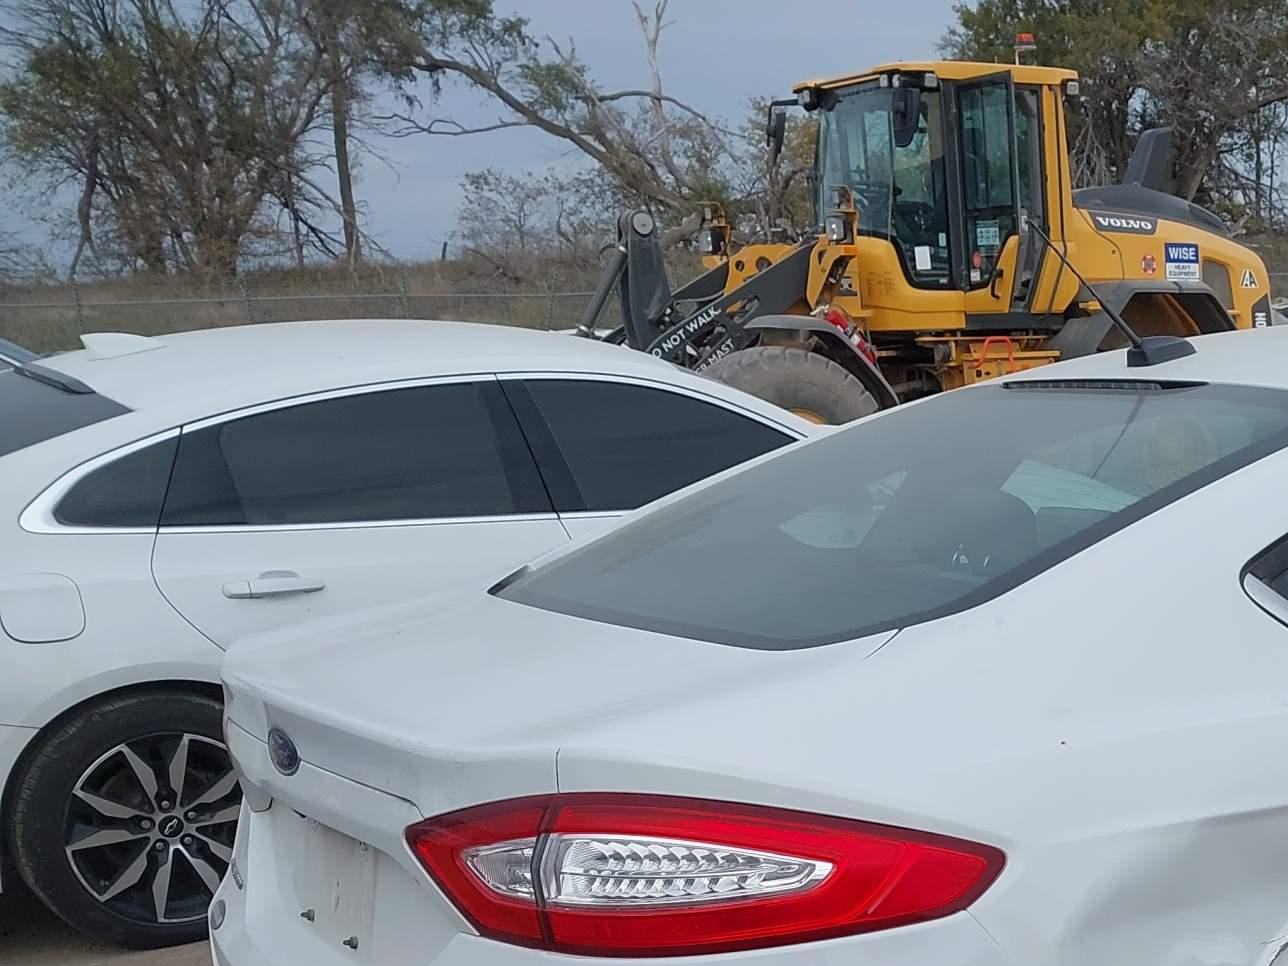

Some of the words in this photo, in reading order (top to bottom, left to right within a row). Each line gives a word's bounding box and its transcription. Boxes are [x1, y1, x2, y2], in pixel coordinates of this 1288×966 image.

[1095, 215, 1153, 231] VOLVO
[1168, 246, 1197, 260] WISE
[661, 328, 687, 353] NOT
[685, 305, 722, 333] WALK
[707, 337, 735, 365] MAST
